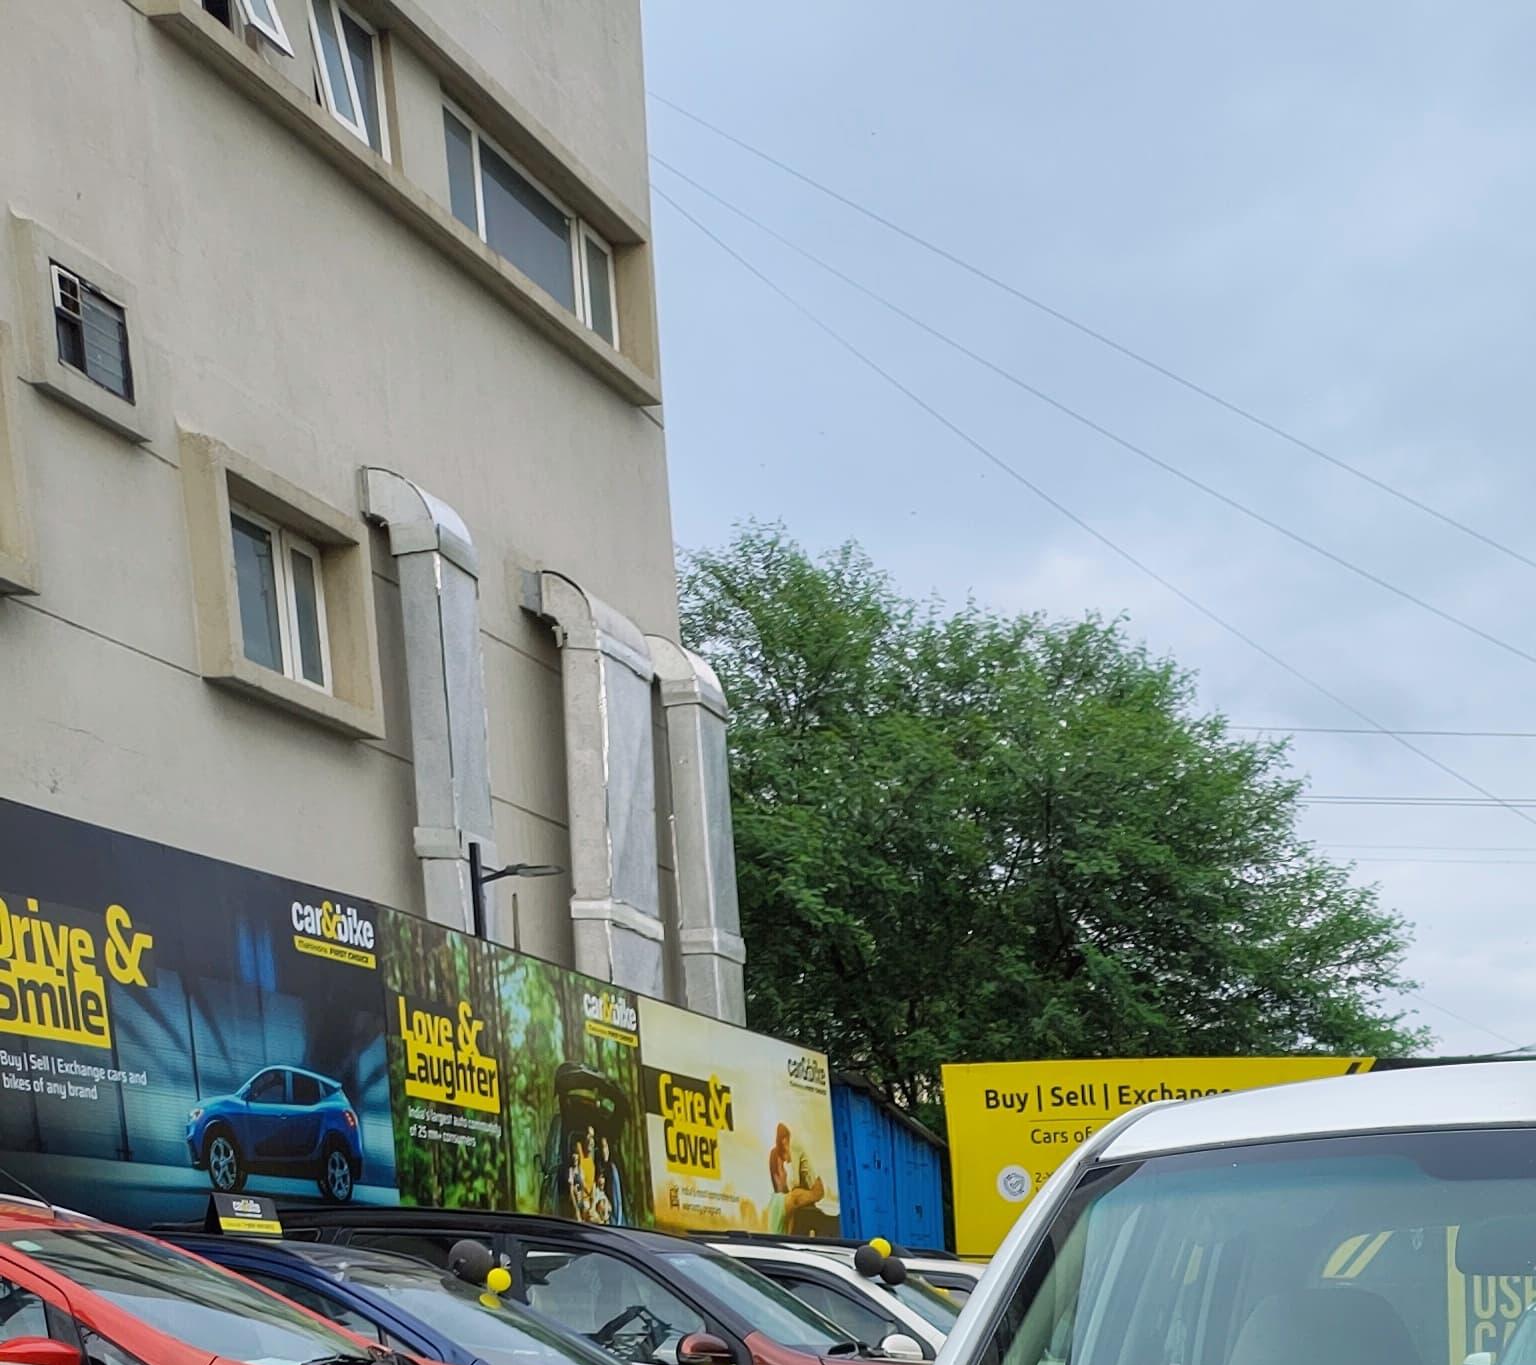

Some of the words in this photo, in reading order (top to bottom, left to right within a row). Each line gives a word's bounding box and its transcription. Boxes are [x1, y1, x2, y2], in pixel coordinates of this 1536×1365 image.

[105, 904, 152, 987] &
[291, 900, 375, 949] car&bike
[398, 996, 453, 1047] Love
[457, 1001, 484, 1058] &
[583, 992, 637, 1031] car&bike
[0, 1051, 23, 1072] Buy
[29, 1055, 50, 1072] Sell
[57, 1058, 106, 1082] Exchange
[107, 1068, 127, 1082] cars
[129, 1071, 148, 1086] and
[2, 1073, 31, 1092] bikes
[33, 1078, 44, 1093] of
[46, 1081, 67, 1100] any
[68, 1084, 98, 1100] brand
[405, 1041, 495, 1100] Laughter
[659, 1073, 706, 1126] Care
[709, 1072, 734, 1131] &
[984, 1089, 1028, 1112] Buy
[1051, 1084, 1096, 1107] Sell
[664, 1118, 717, 1169] Cover
[1031, 1128, 1068, 1144] Cars
